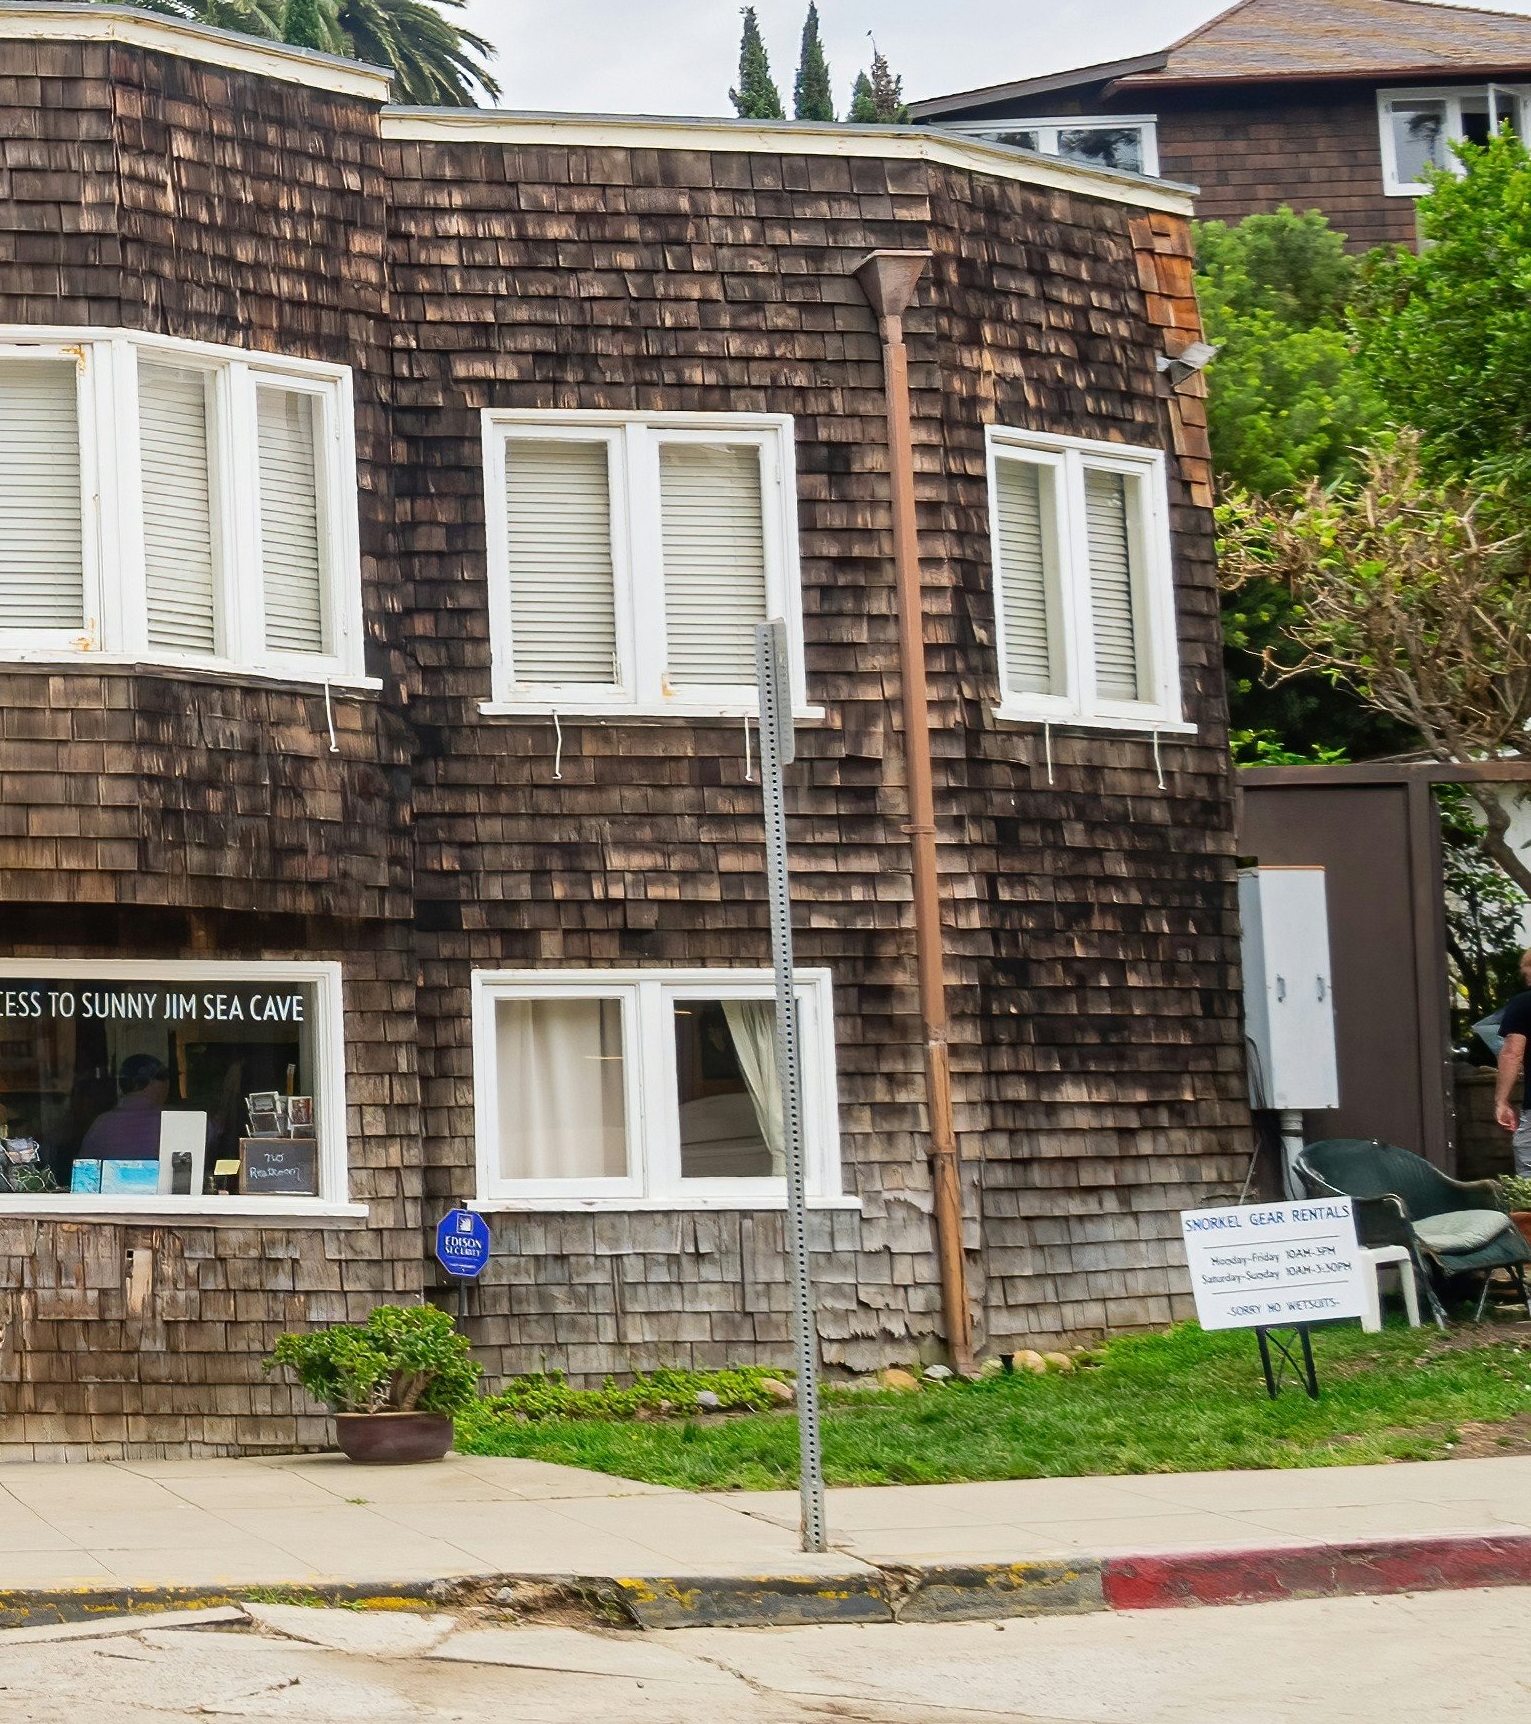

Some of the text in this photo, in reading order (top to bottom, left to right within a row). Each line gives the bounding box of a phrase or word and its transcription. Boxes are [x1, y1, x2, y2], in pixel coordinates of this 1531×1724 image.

[48, 991, 76, 1018] TO
[82, 992, 156, 1020] SUNNY
[163, 993, 197, 1020] JIM
[203, 994, 245, 1022] SEA
[249, 994, 305, 1023] CAVE
[1185, 1204, 1352, 1232] SNORKEL GEAR RENTALS
[444, 1235, 483, 1249] EDISON
